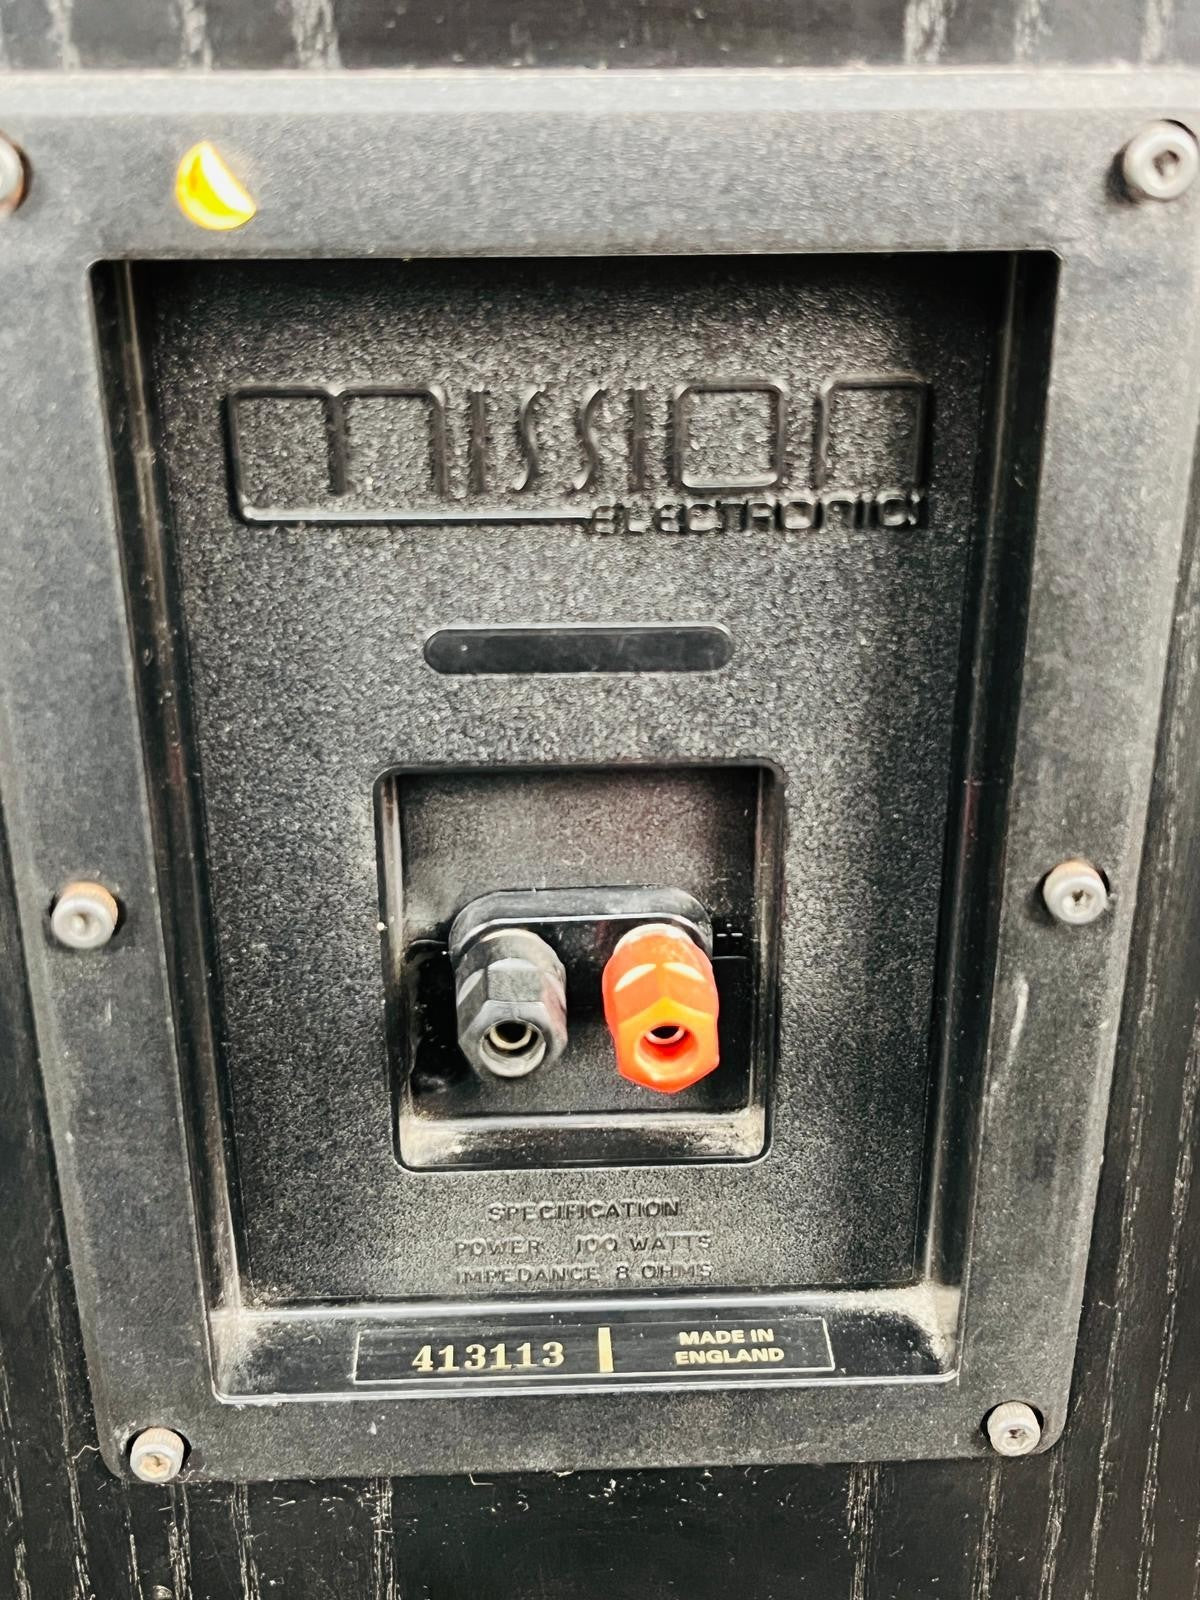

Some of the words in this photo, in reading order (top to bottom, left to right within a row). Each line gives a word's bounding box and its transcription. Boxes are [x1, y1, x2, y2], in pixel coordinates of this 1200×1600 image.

[487, 1199, 680, 1222] SPECIFICATION
[454, 1235, 543, 1256] POWER
[575, 1232, 619, 1253] 100
[629, 1230, 712, 1252] WATTS
[455, 1263, 602, 1285] IMPEDANCE
[615, 1264, 630, 1280] 8
[641, 1261, 713, 1280] OHMS
[678, 1330, 744, 1346] MADE
[749, 1328, 775, 1343] IN
[411, 1341, 565, 1373] 413113
[674, 1347, 785, 1365] ENGLAND
